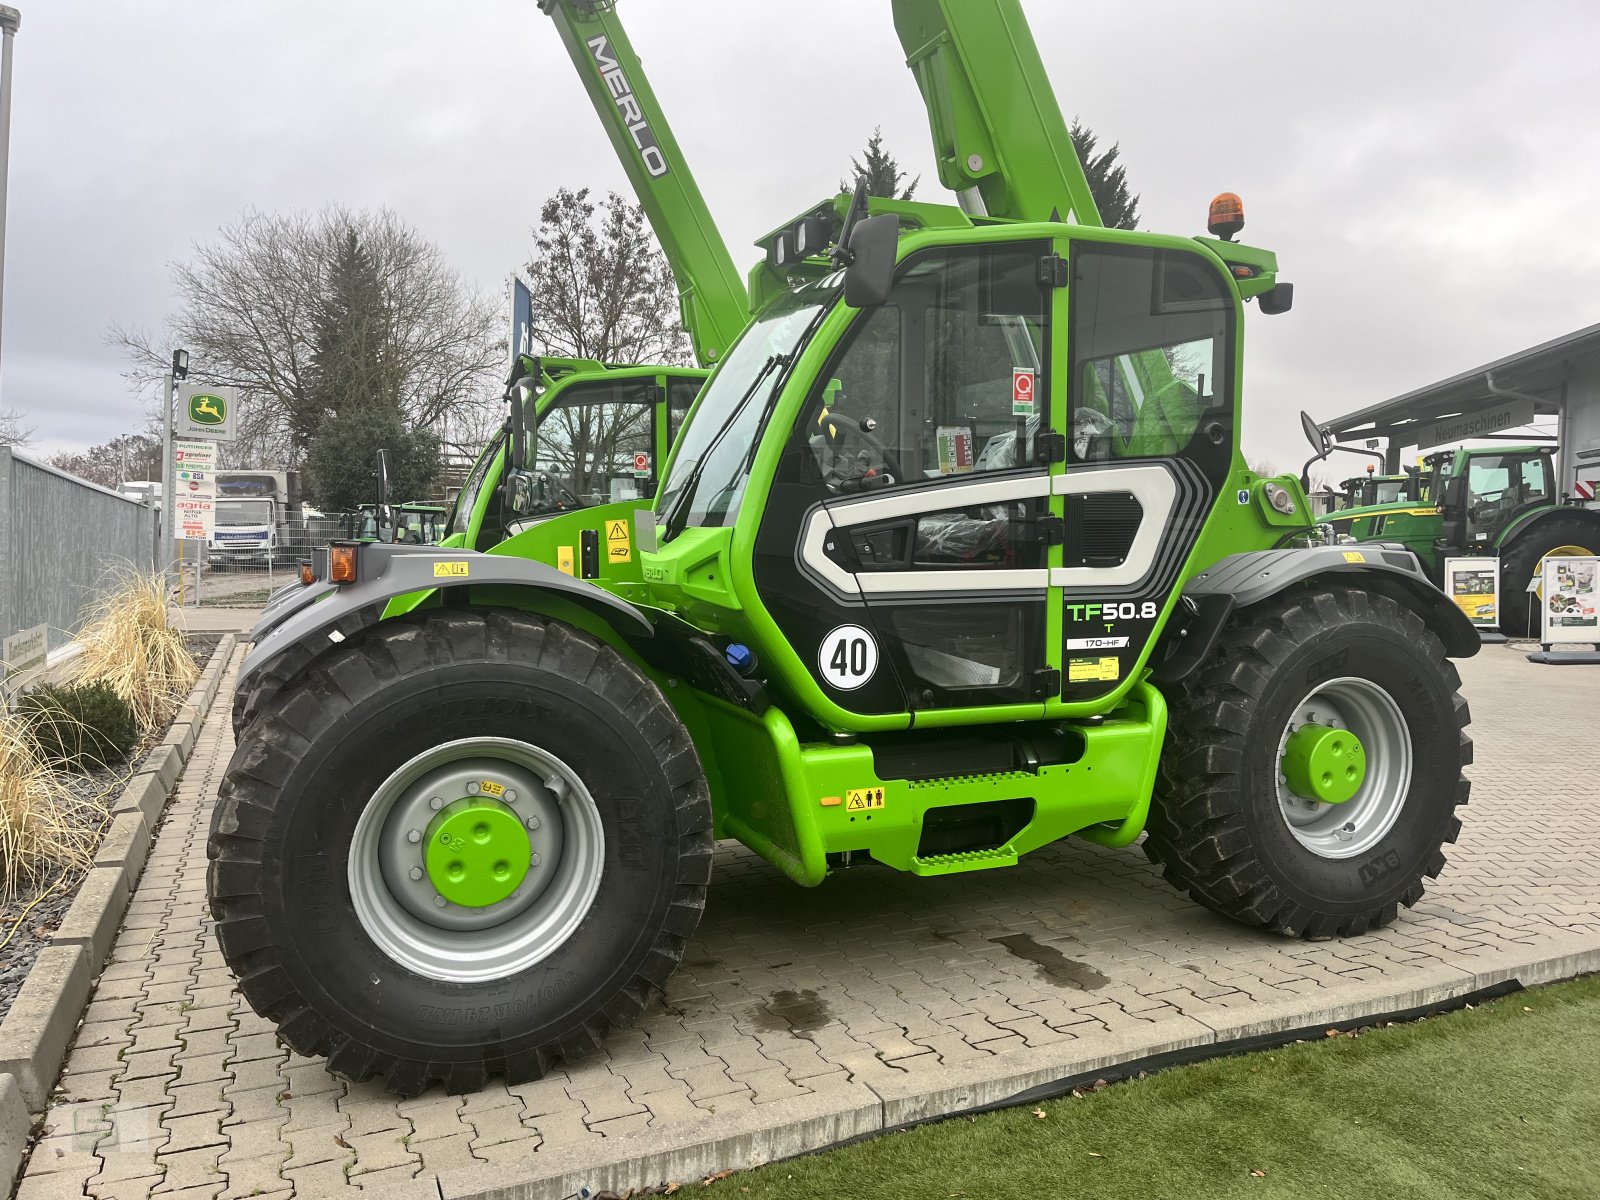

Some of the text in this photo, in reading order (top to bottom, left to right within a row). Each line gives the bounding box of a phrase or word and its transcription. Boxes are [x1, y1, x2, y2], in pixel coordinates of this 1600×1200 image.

[587, 35, 667, 177] MERLO
[205, 427, 227, 435] DEERE
[1435, 412, 1511, 443] Neumaschinen
[176, 502, 211, 510] agria
[1066, 601, 1157, 622] TF50.8
[1085, 639, 1120, 648] 170-HF
[830, 638, 867, 678] 40
[1358, 849, 1402, 889] BKT
